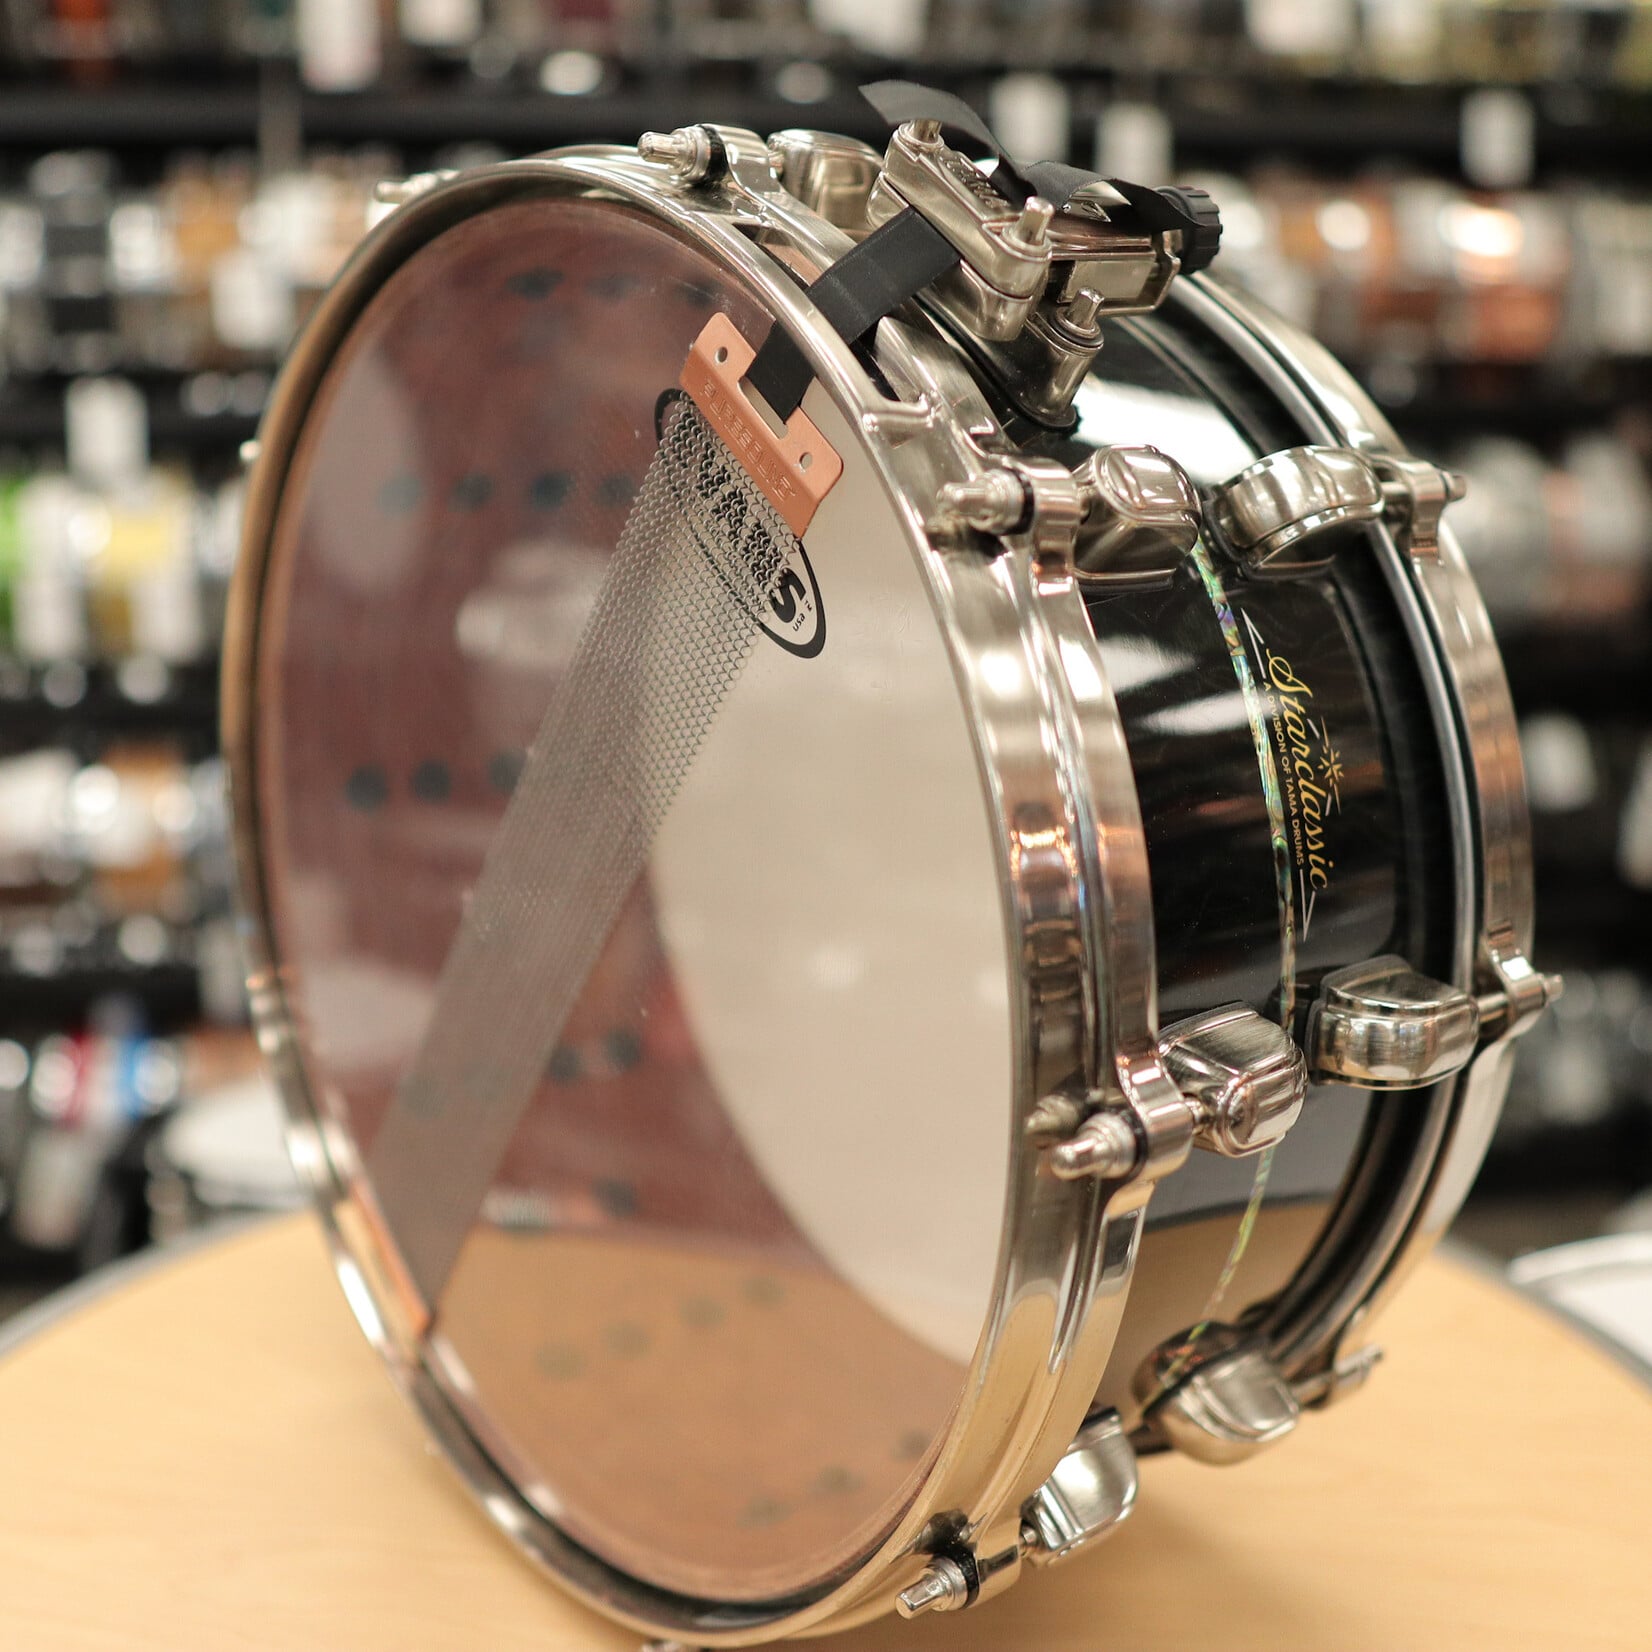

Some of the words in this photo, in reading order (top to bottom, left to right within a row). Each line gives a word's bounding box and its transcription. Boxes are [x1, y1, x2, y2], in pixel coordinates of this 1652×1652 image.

[1263, 681, 1272, 692] A
[1267, 695, 1287, 753] DIVISION
[1265, 648, 1335, 890] Starclassic
[1281, 756, 1292, 774] OF
[1285, 777, 1298, 816] TAMA
[1291, 819, 1304, 866] DRUMS
